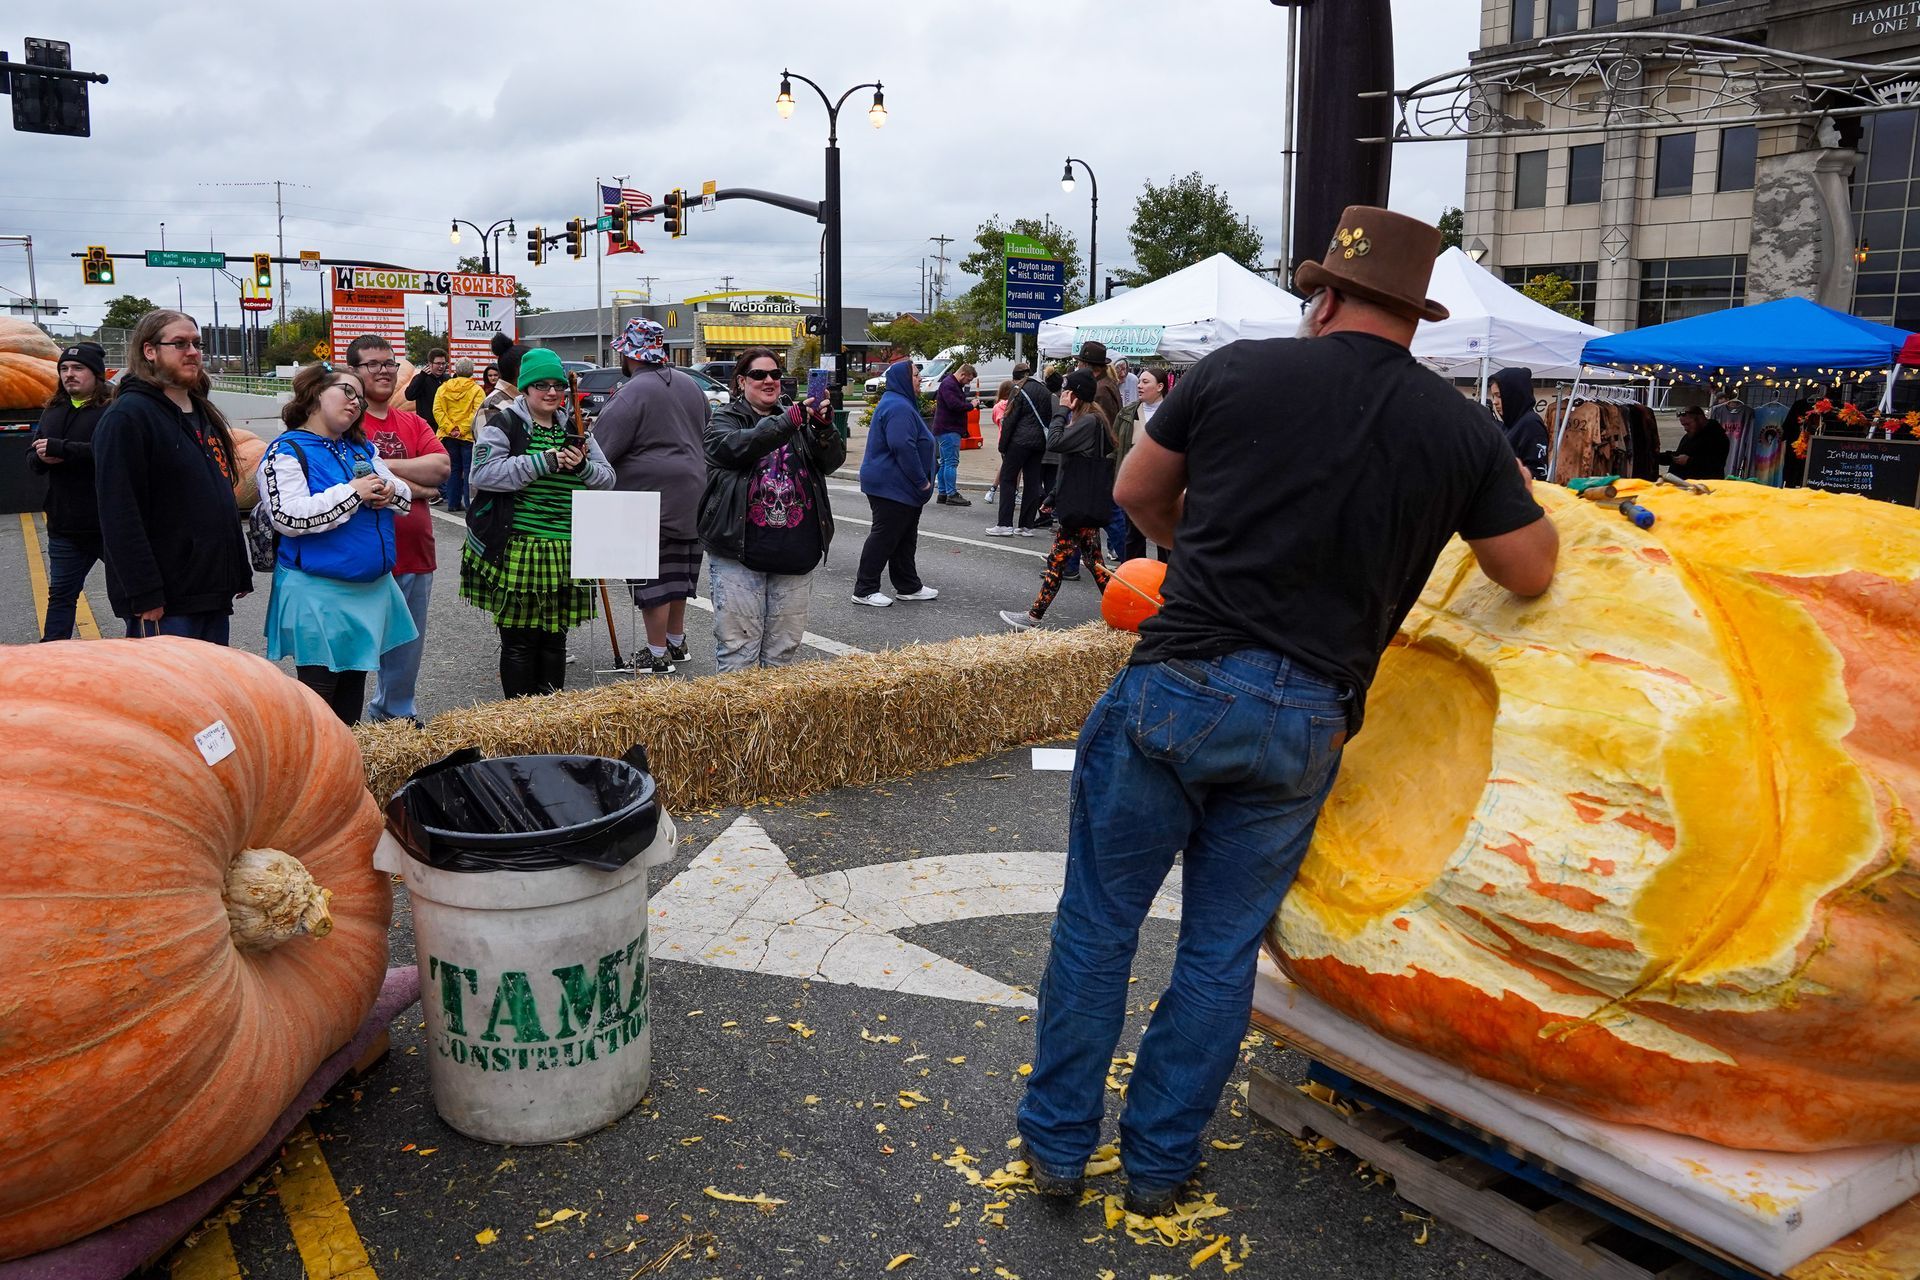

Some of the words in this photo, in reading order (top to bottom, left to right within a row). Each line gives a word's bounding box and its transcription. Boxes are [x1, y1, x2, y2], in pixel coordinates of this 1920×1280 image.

[1851, 1, 1920, 25] HAMILT
[1872, 17, 1909, 35] ONE
[1007, 242, 1045, 255] Hamilton
[182, 256, 197, 265] King
[1018, 261, 1039, 272] Dayton
[1041, 264, 1055, 272] Lane
[335, 266, 421, 290] WELCOME
[436, 272, 515, 296] GROWERS
[1018, 271, 1031, 279] Hist.
[1033, 272, 1055, 281] District
[1007, 290, 1033, 300] Pyramid
[1034, 292, 1045, 300] Hill
[729, 301, 801, 313] McDonald's
[1007, 311, 1026, 319] Miami
[1027, 311, 1042, 320] Univ.
[465, 319, 502, 332] TAMZ
[1007, 320, 1035, 329] Hamilton
[1077, 327, 1161, 345] HEADBANDS
[430, 928, 648, 1043] TAMZ
